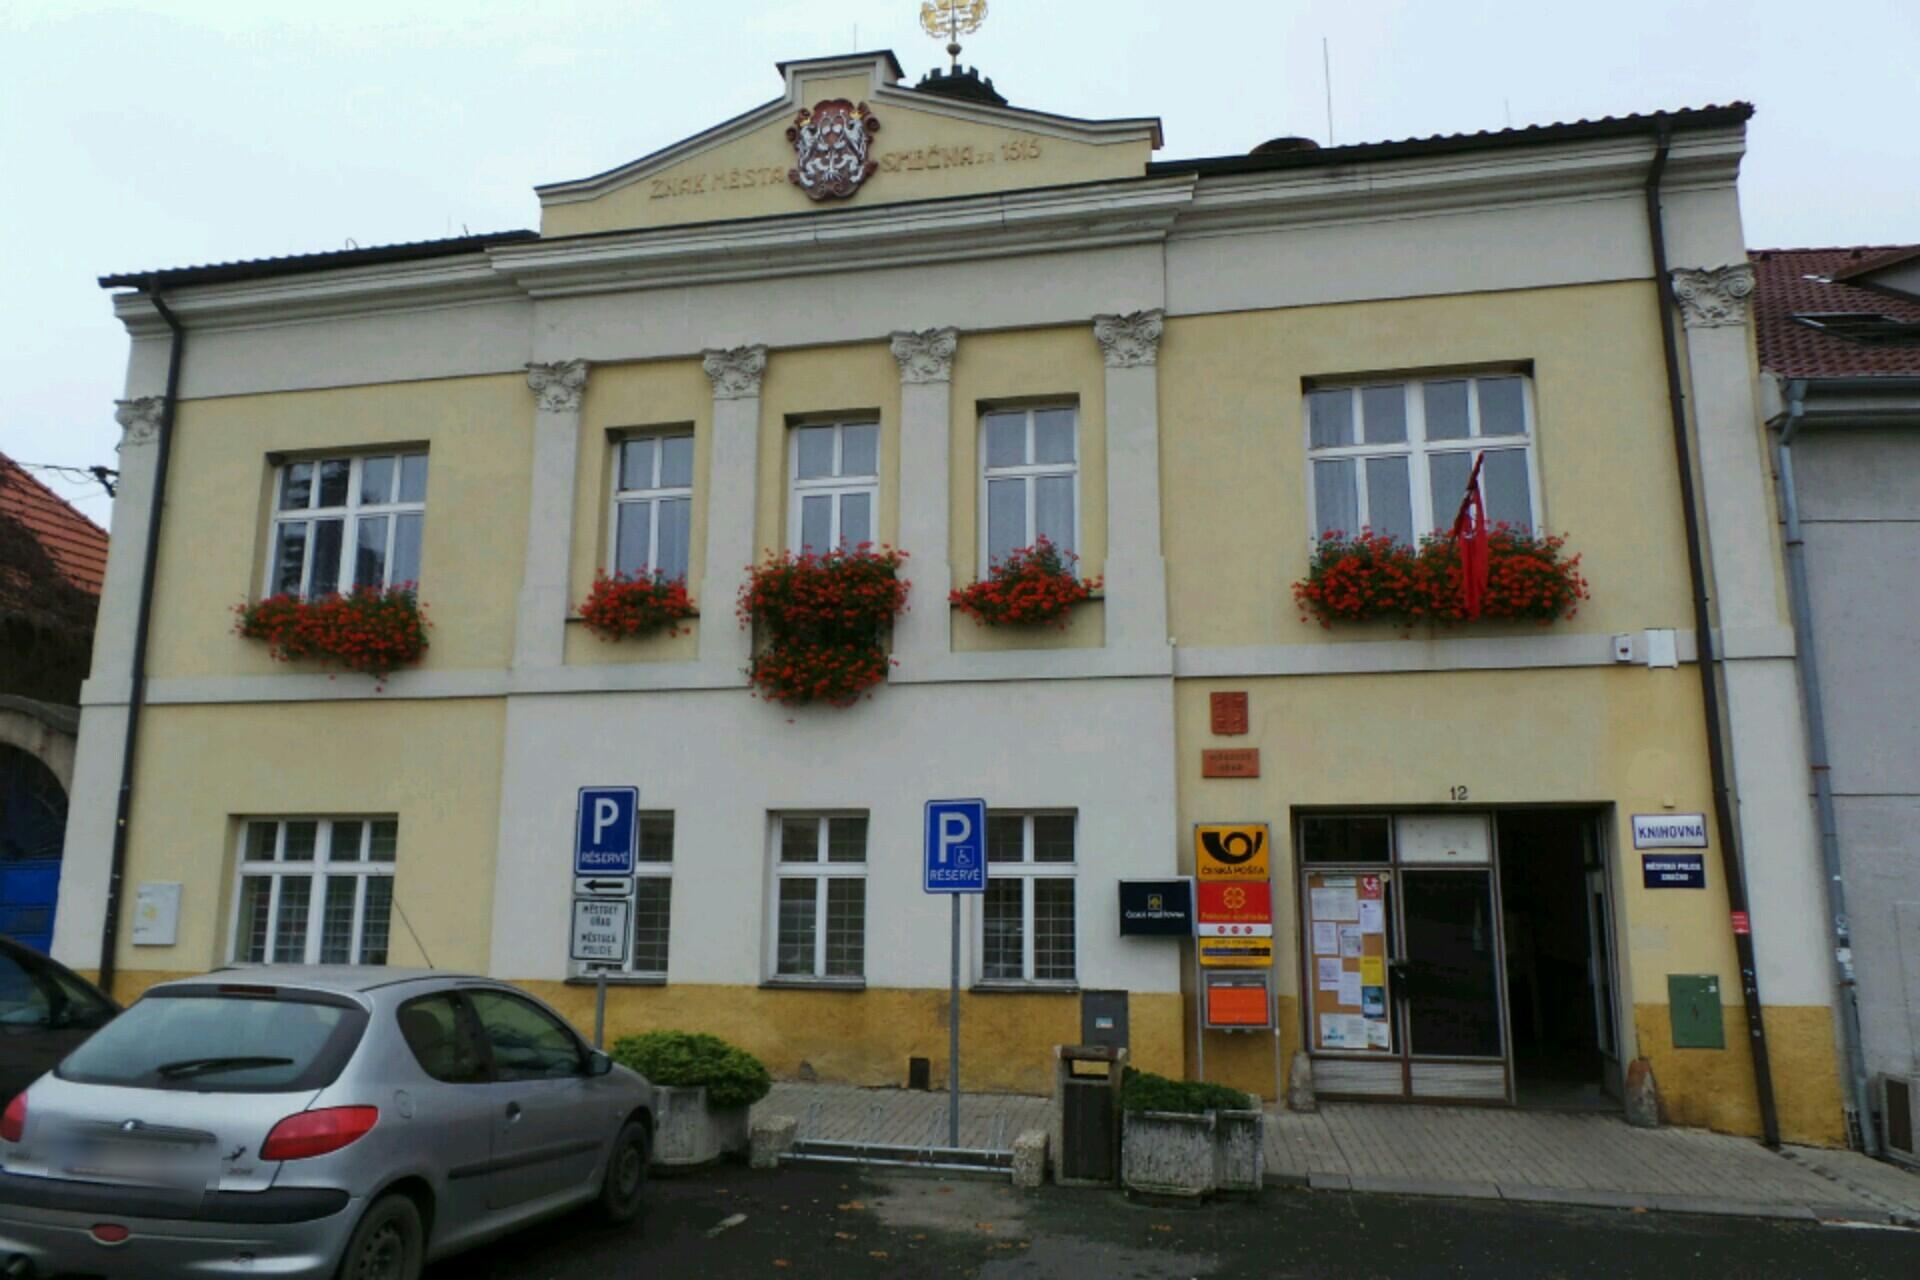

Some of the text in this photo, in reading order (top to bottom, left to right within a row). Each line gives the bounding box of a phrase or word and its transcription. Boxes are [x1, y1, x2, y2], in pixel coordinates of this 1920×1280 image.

[1450, 785, 1468, 801] 12
[593, 797, 619, 845] P
[1638, 825, 1703, 839] KNIHOVNA
[938, 812, 971, 863] P
